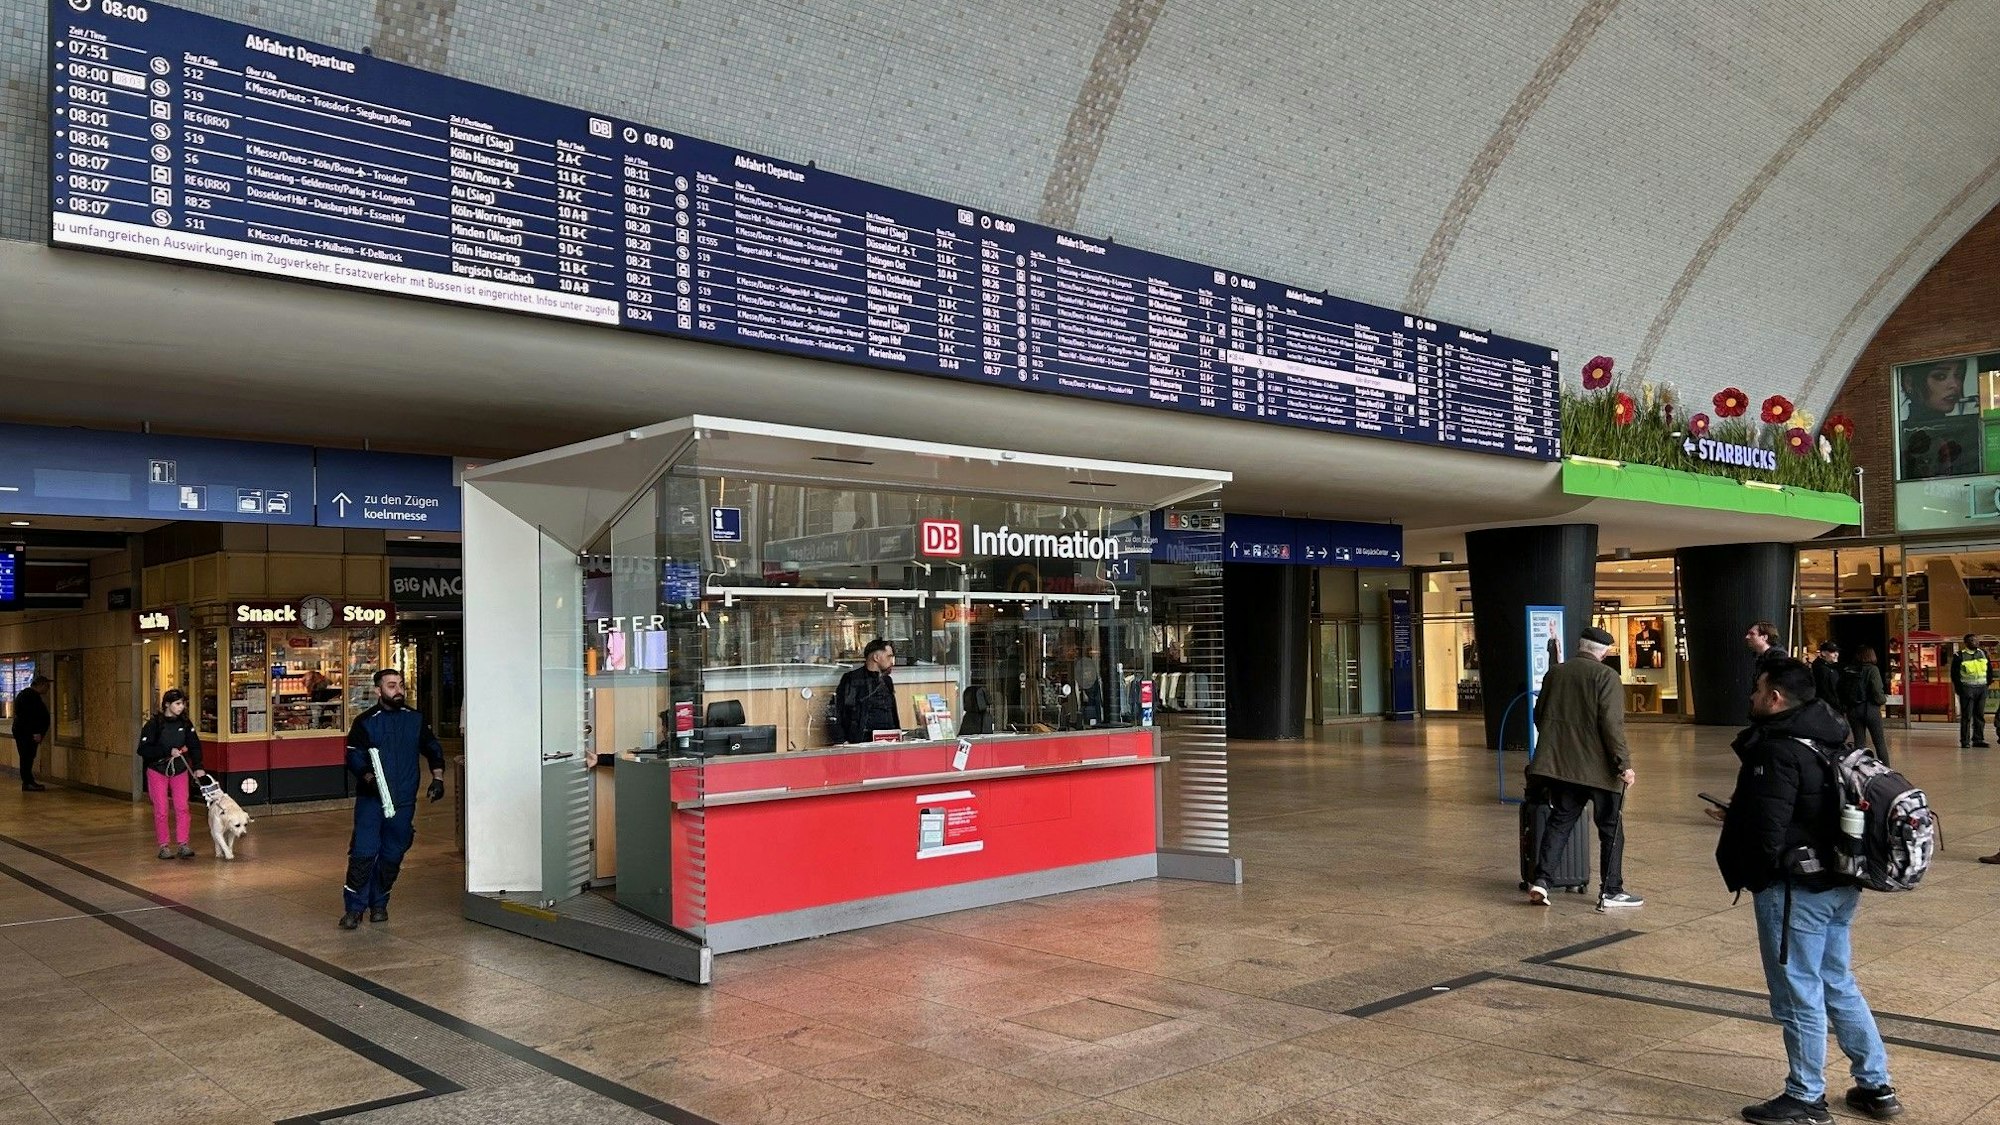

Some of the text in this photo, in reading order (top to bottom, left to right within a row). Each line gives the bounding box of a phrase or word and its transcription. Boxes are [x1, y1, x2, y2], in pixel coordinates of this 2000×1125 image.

[101, 0, 147, 22] 08:00
[69, 40, 109, 60] 07:51
[245, 34, 355, 73] Abfahrt Departure
[69, 62, 109, 83] 08:00
[184, 67, 204, 81] S12
[69, 84, 109, 104] 08:01
[184, 89, 204, 102] S19
[252, 82, 306, 103] Messe/Deutz
[313, 96, 350, 113] Troisdorf
[356, 107, 412, 127] Siegburg/Bonn
[69, 107, 109, 127] 08:01
[69, 129, 109, 149] 08:04
[184, 132, 204, 145] S19
[450, 126, 514, 152] Hennef (Sieg)
[69, 152, 109, 171] 08:07
[185, 153, 199, 164] S6
[253, 146, 307, 166] Messe/Deutz
[373, 169, 408, 185] Troisdorf
[451, 147, 519, 174] Köln Hansaring
[557, 151, 581, 166] 2 A-C
[253, 167, 294, 185] Hansaring
[451, 167, 500, 186] Köln/Bonn
[624, 166, 649, 181] 08:11
[735, 155, 805, 182] Abfahrt Departure
[69, 175, 109, 193] 08:07
[558, 170, 587, 185] 11 B-C
[451, 185, 495, 205] Au (Sieg)
[558, 188, 582, 203] 3 A-C
[625, 184, 650, 199] 08:14
[69, 197, 109, 215] 08:07
[558, 206, 588, 222] 10 A-B
[625, 202, 650, 216] 08:17
[185, 217, 205, 230] S11
[451, 203, 523, 227] Köln-Worringen
[452, 223, 522, 247] Minden (Westf)
[558, 224, 587, 239] 11 B-C
[625, 219, 650, 234] 08:20
[866, 222, 888, 235] Hennef
[254, 229, 308, 247] Messe/Deutz
[626, 237, 651, 251] 08:20
[866, 238, 900, 253] Düsseldorf
[452, 242, 520, 266] Köln Hansaring
[559, 242, 583, 256] 9 D-G
[559, 260, 588, 275] 11 B-C
[626, 254, 651, 269] 08:21
[867, 253, 906, 270] Ratingen Ost
[69, 224, 159, 246] umfangreichen
[164, 237, 248, 261] Auswirkungen
[250, 251, 264, 262] im
[266, 252, 333, 273] Zugverkehr.
[334, 263, 406, 285] Ersatzverkehr
[410, 275, 425, 287] mit
[428, 278, 461, 293] Bussen
[464, 284, 476, 295] ist
[478, 285, 533, 304] eingerichtet.
[536, 294, 558, 308] Infos
[560, 299, 583, 312] unter
[585, 302, 616, 317] zuginfo
[452, 262, 534, 285] Bergisch Gladbach
[867, 269, 885, 282] Berlin
[560, 279, 589, 294] 10 A-B
[626, 272, 651, 287] 08:21
[627, 290, 652, 304] 08:23
[867, 285, 912, 303] Köln Hansaring
[627, 307, 652, 321] 08:24
[868, 315, 890, 328] Hennef
[1698, 438, 1776, 471] STARBUCKS
[364, 494, 439, 508] zu den Zügen
[364, 507, 427, 521] koelnmesse
[926, 524, 1119, 560] DB Information
[421, 576, 463, 598] MAC
[237, 604, 386, 624] Snack Stop
